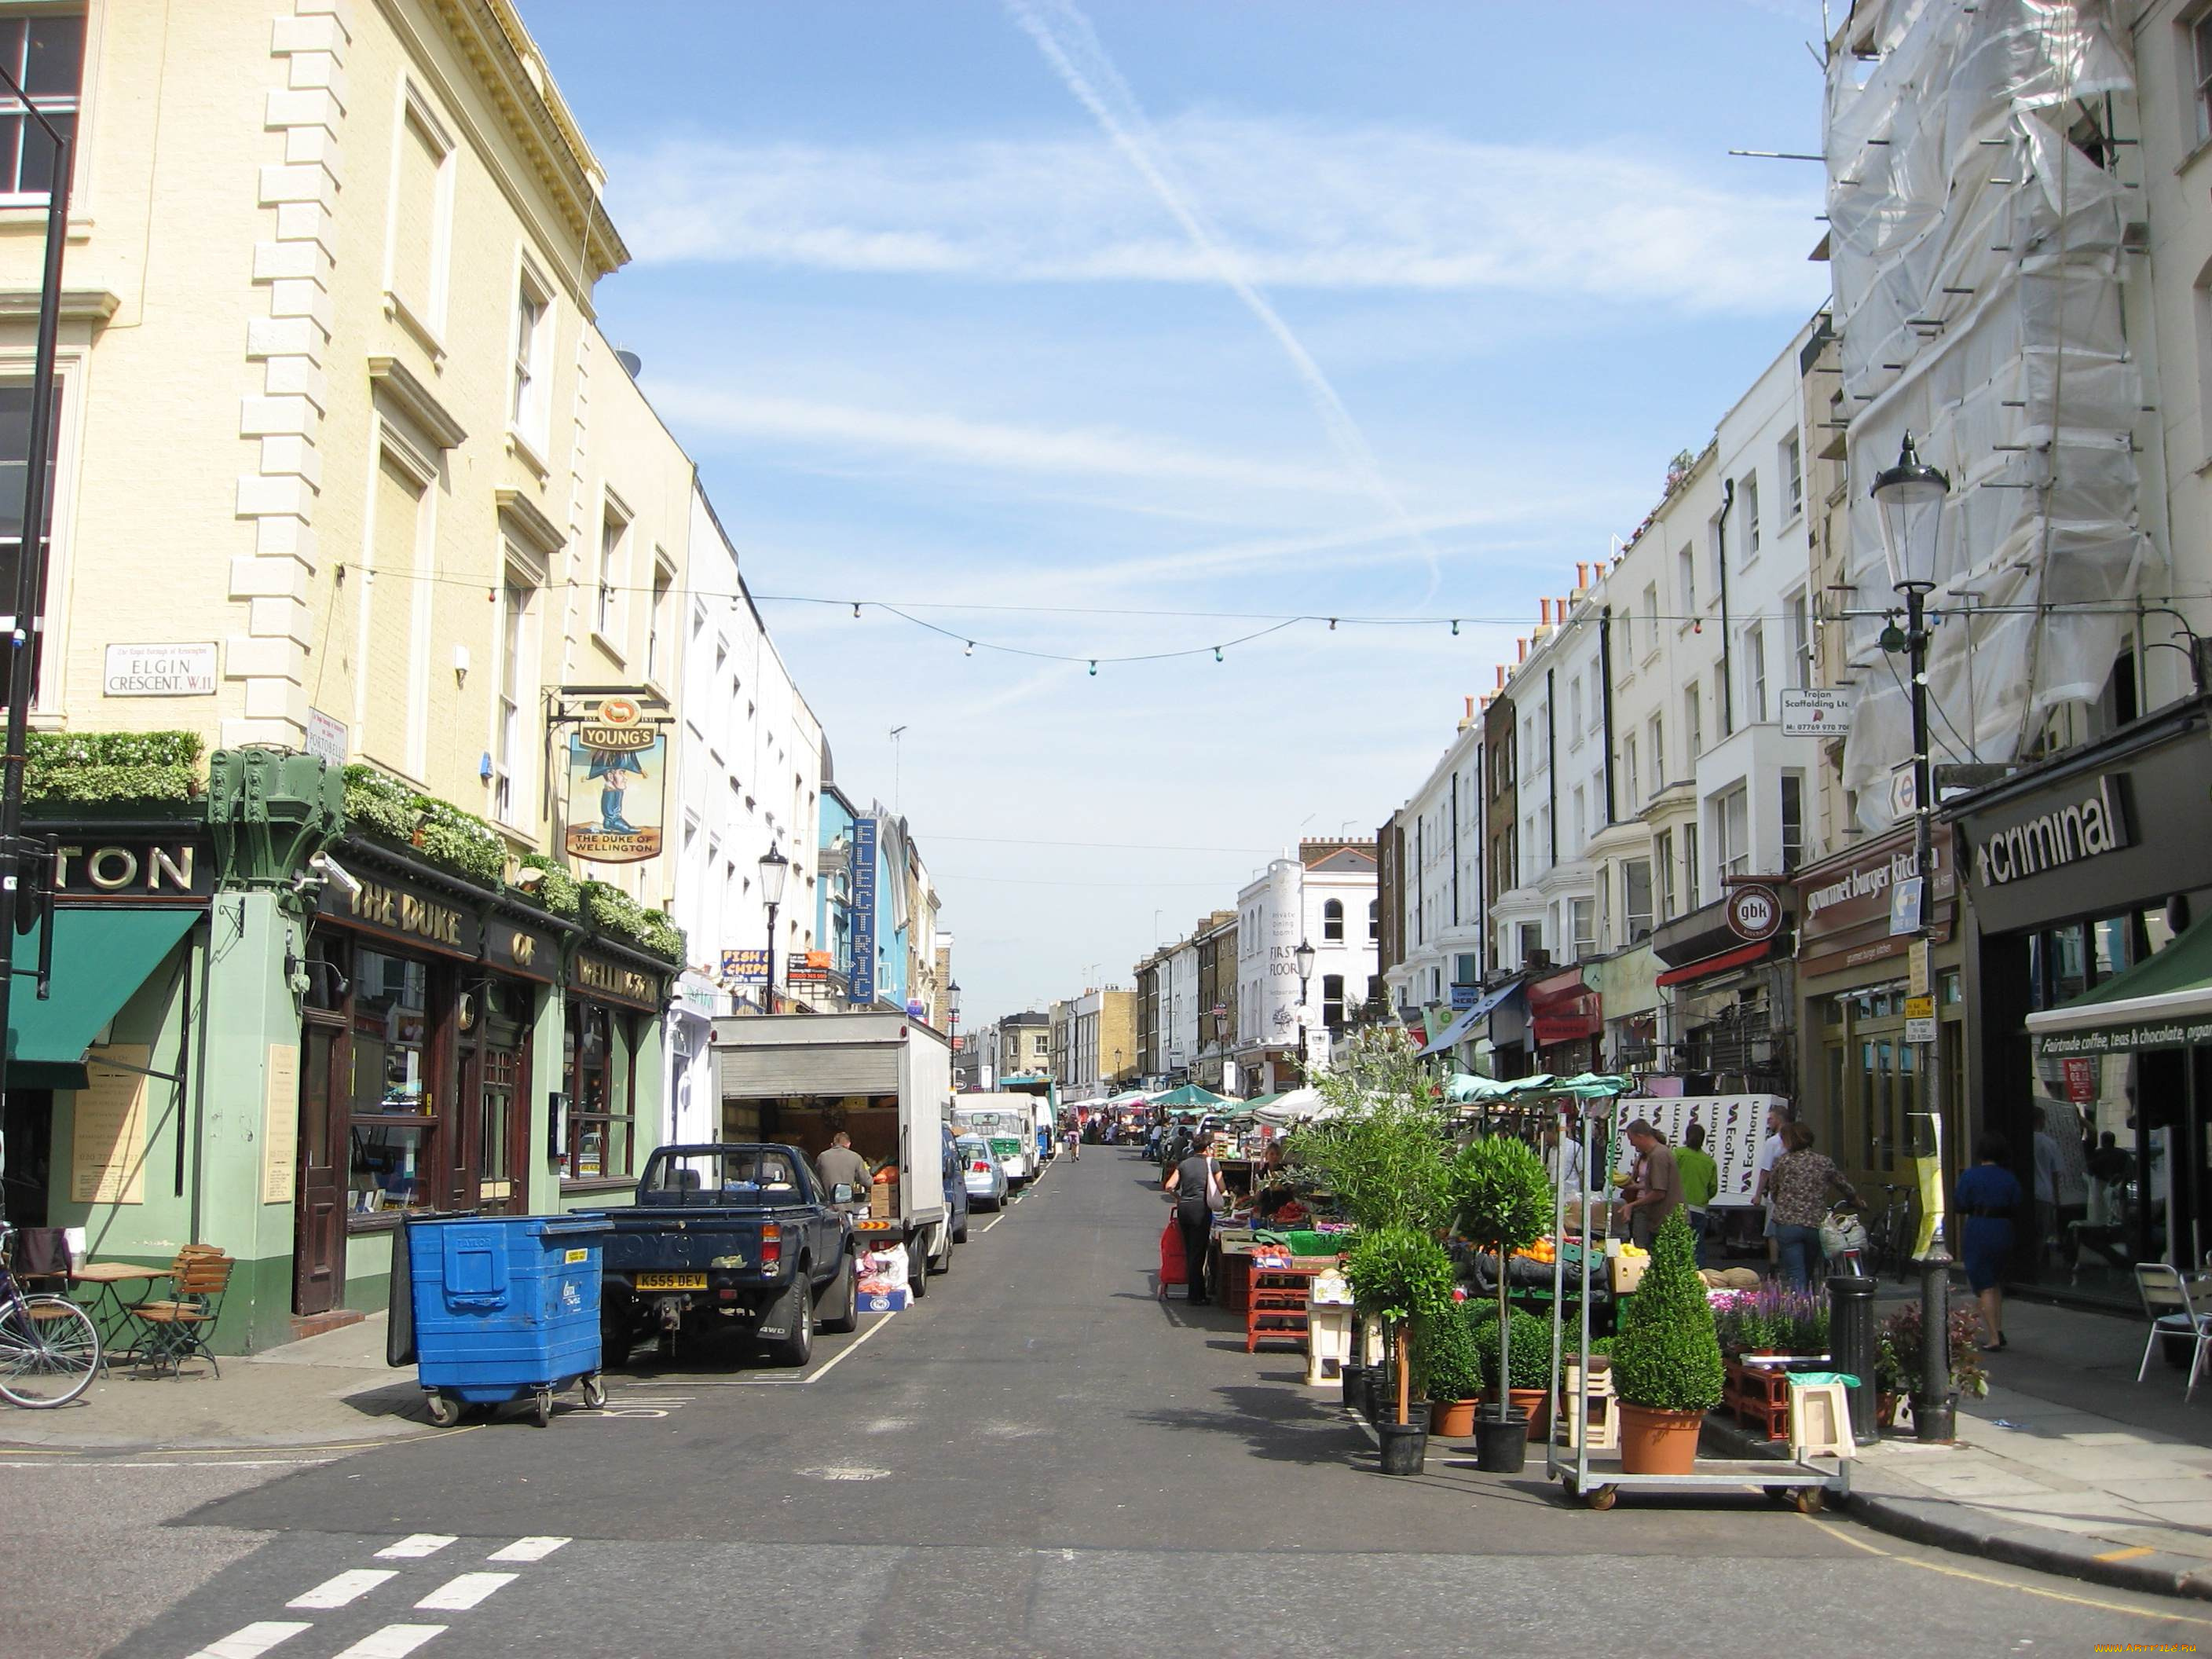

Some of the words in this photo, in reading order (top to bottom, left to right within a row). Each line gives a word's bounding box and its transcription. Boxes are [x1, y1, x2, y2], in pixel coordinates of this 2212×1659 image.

[132, 660, 189, 674] ELGIN
[1785, 700, 1834, 709] Scaffolding
[587, 730, 650, 745] YOUNG'S
[1990, 775, 2116, 883] criminal
[1807, 875, 1853, 921] gourmet
[1852, 865, 1891, 899] burger
[854, 825, 874, 997] ELECTRIC
[1741, 903, 1767, 921] gbk
[352, 878, 398, 928] THE
[401, 893, 463, 947] DUKE
[513, 932, 537, 966] OF
[723, 951, 760, 961] FISH
[1269, 946, 1298, 960] FIRST
[727, 964, 768, 975] CHIPS
[1269, 963, 1299, 976] FLOOR
[2042, 1038, 2081, 1053] Fairtrade
[2081, 1033, 2108, 1050] coffee,
[2111, 1033, 2130, 1047] teas
[2131, 1029, 2138, 1045] &
[2140, 1026, 2184, 1045] chocolate,
[1706, 1102, 1719, 1158] coTherm
[1743, 1101, 1760, 1168] EcoTherm
[1720, 1127, 1737, 1193] EcoTherm
[678, 1276, 702, 1287] DEV
